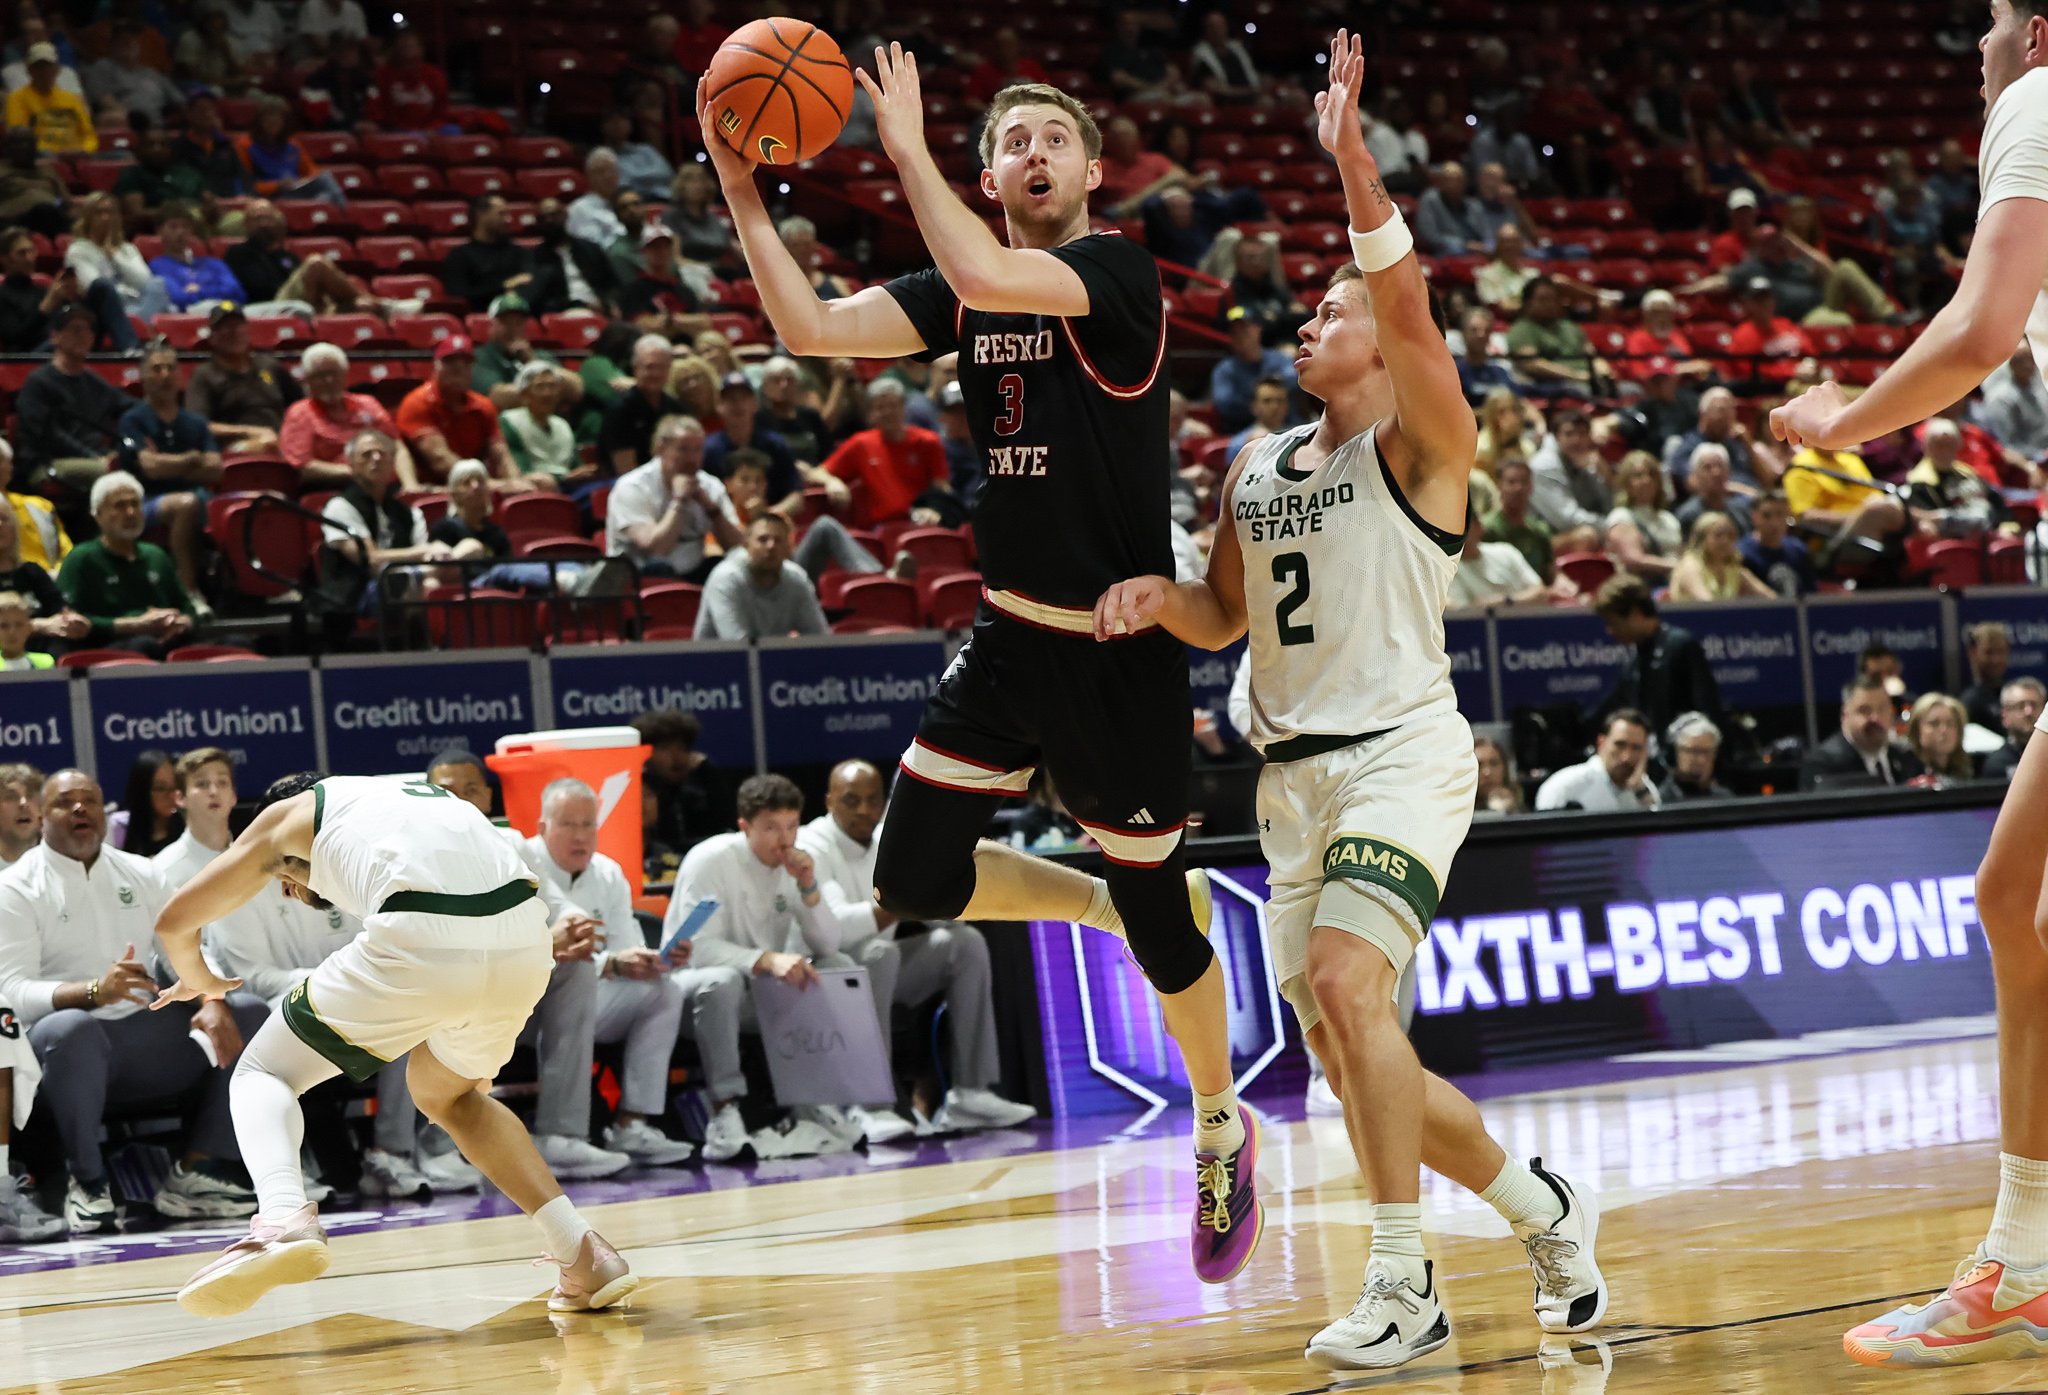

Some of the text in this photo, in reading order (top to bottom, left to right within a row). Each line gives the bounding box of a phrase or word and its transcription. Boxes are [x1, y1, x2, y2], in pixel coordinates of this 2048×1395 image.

[994, 373, 1025, 436] 3
[1236, 482, 1354, 521] COLORADO
[1251, 512, 1323, 542] STATE
[1271, 551, 1315, 647] 2
[334, 693, 523, 730] Credit Union1
[562, 682, 742, 717] Credit Union1
[769, 679, 848, 708] Credit
[104, 705, 304, 741] Credit Union1
[1326, 843, 1409, 881] RAMS
